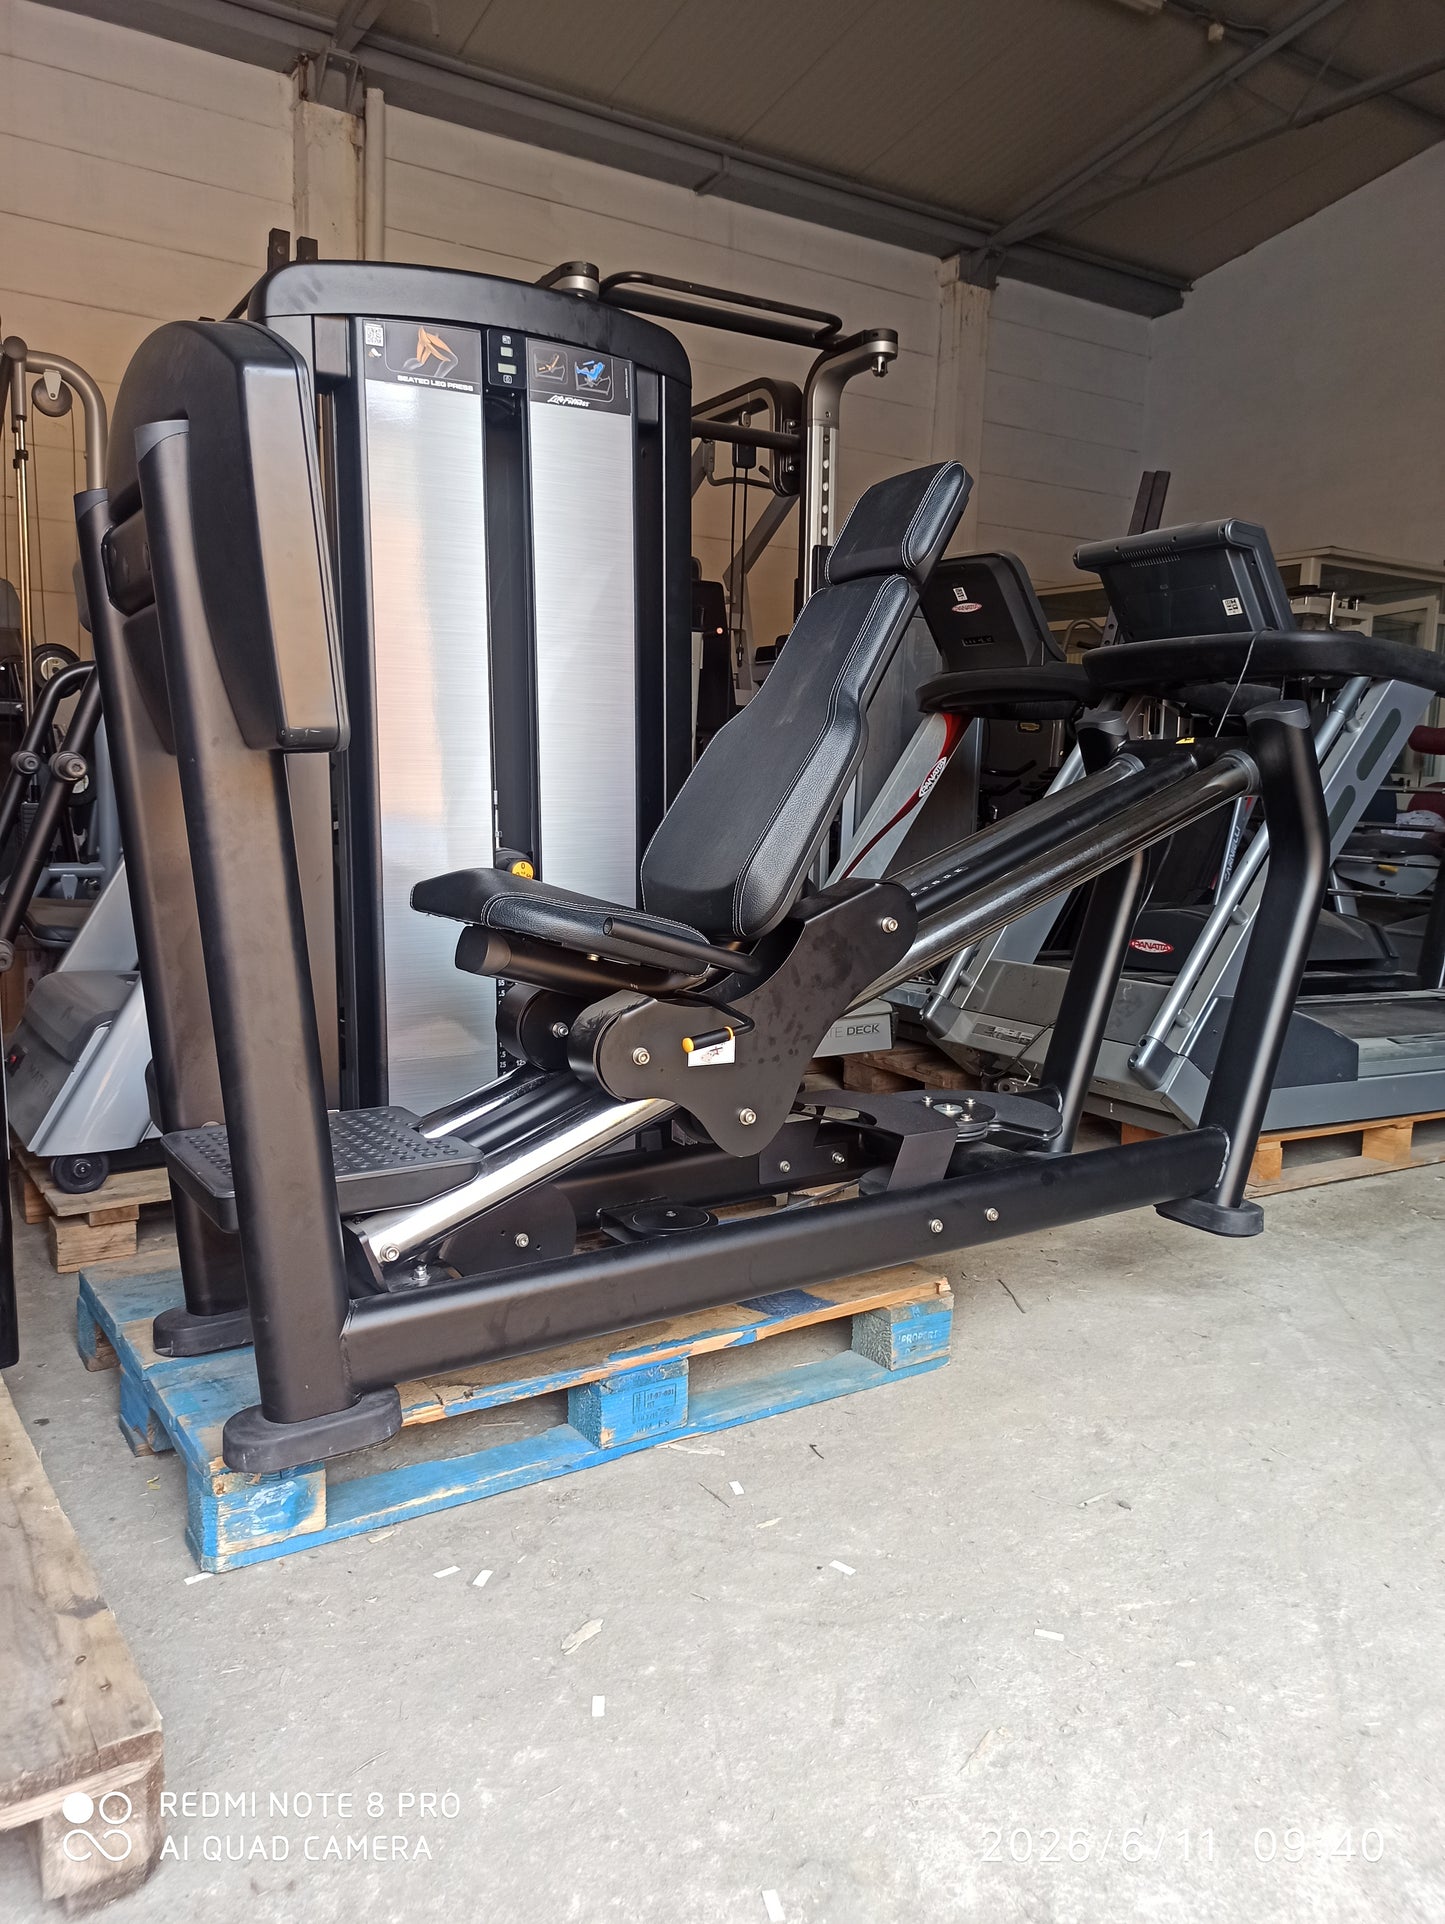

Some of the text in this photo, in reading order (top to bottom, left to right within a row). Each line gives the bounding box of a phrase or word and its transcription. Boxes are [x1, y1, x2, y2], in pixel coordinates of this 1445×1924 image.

[397, 375, 474, 392] SEATED LEG PRESS
[1132, 940, 1172, 952] PANATTA
[847, 1023, 880, 1036] DECK
